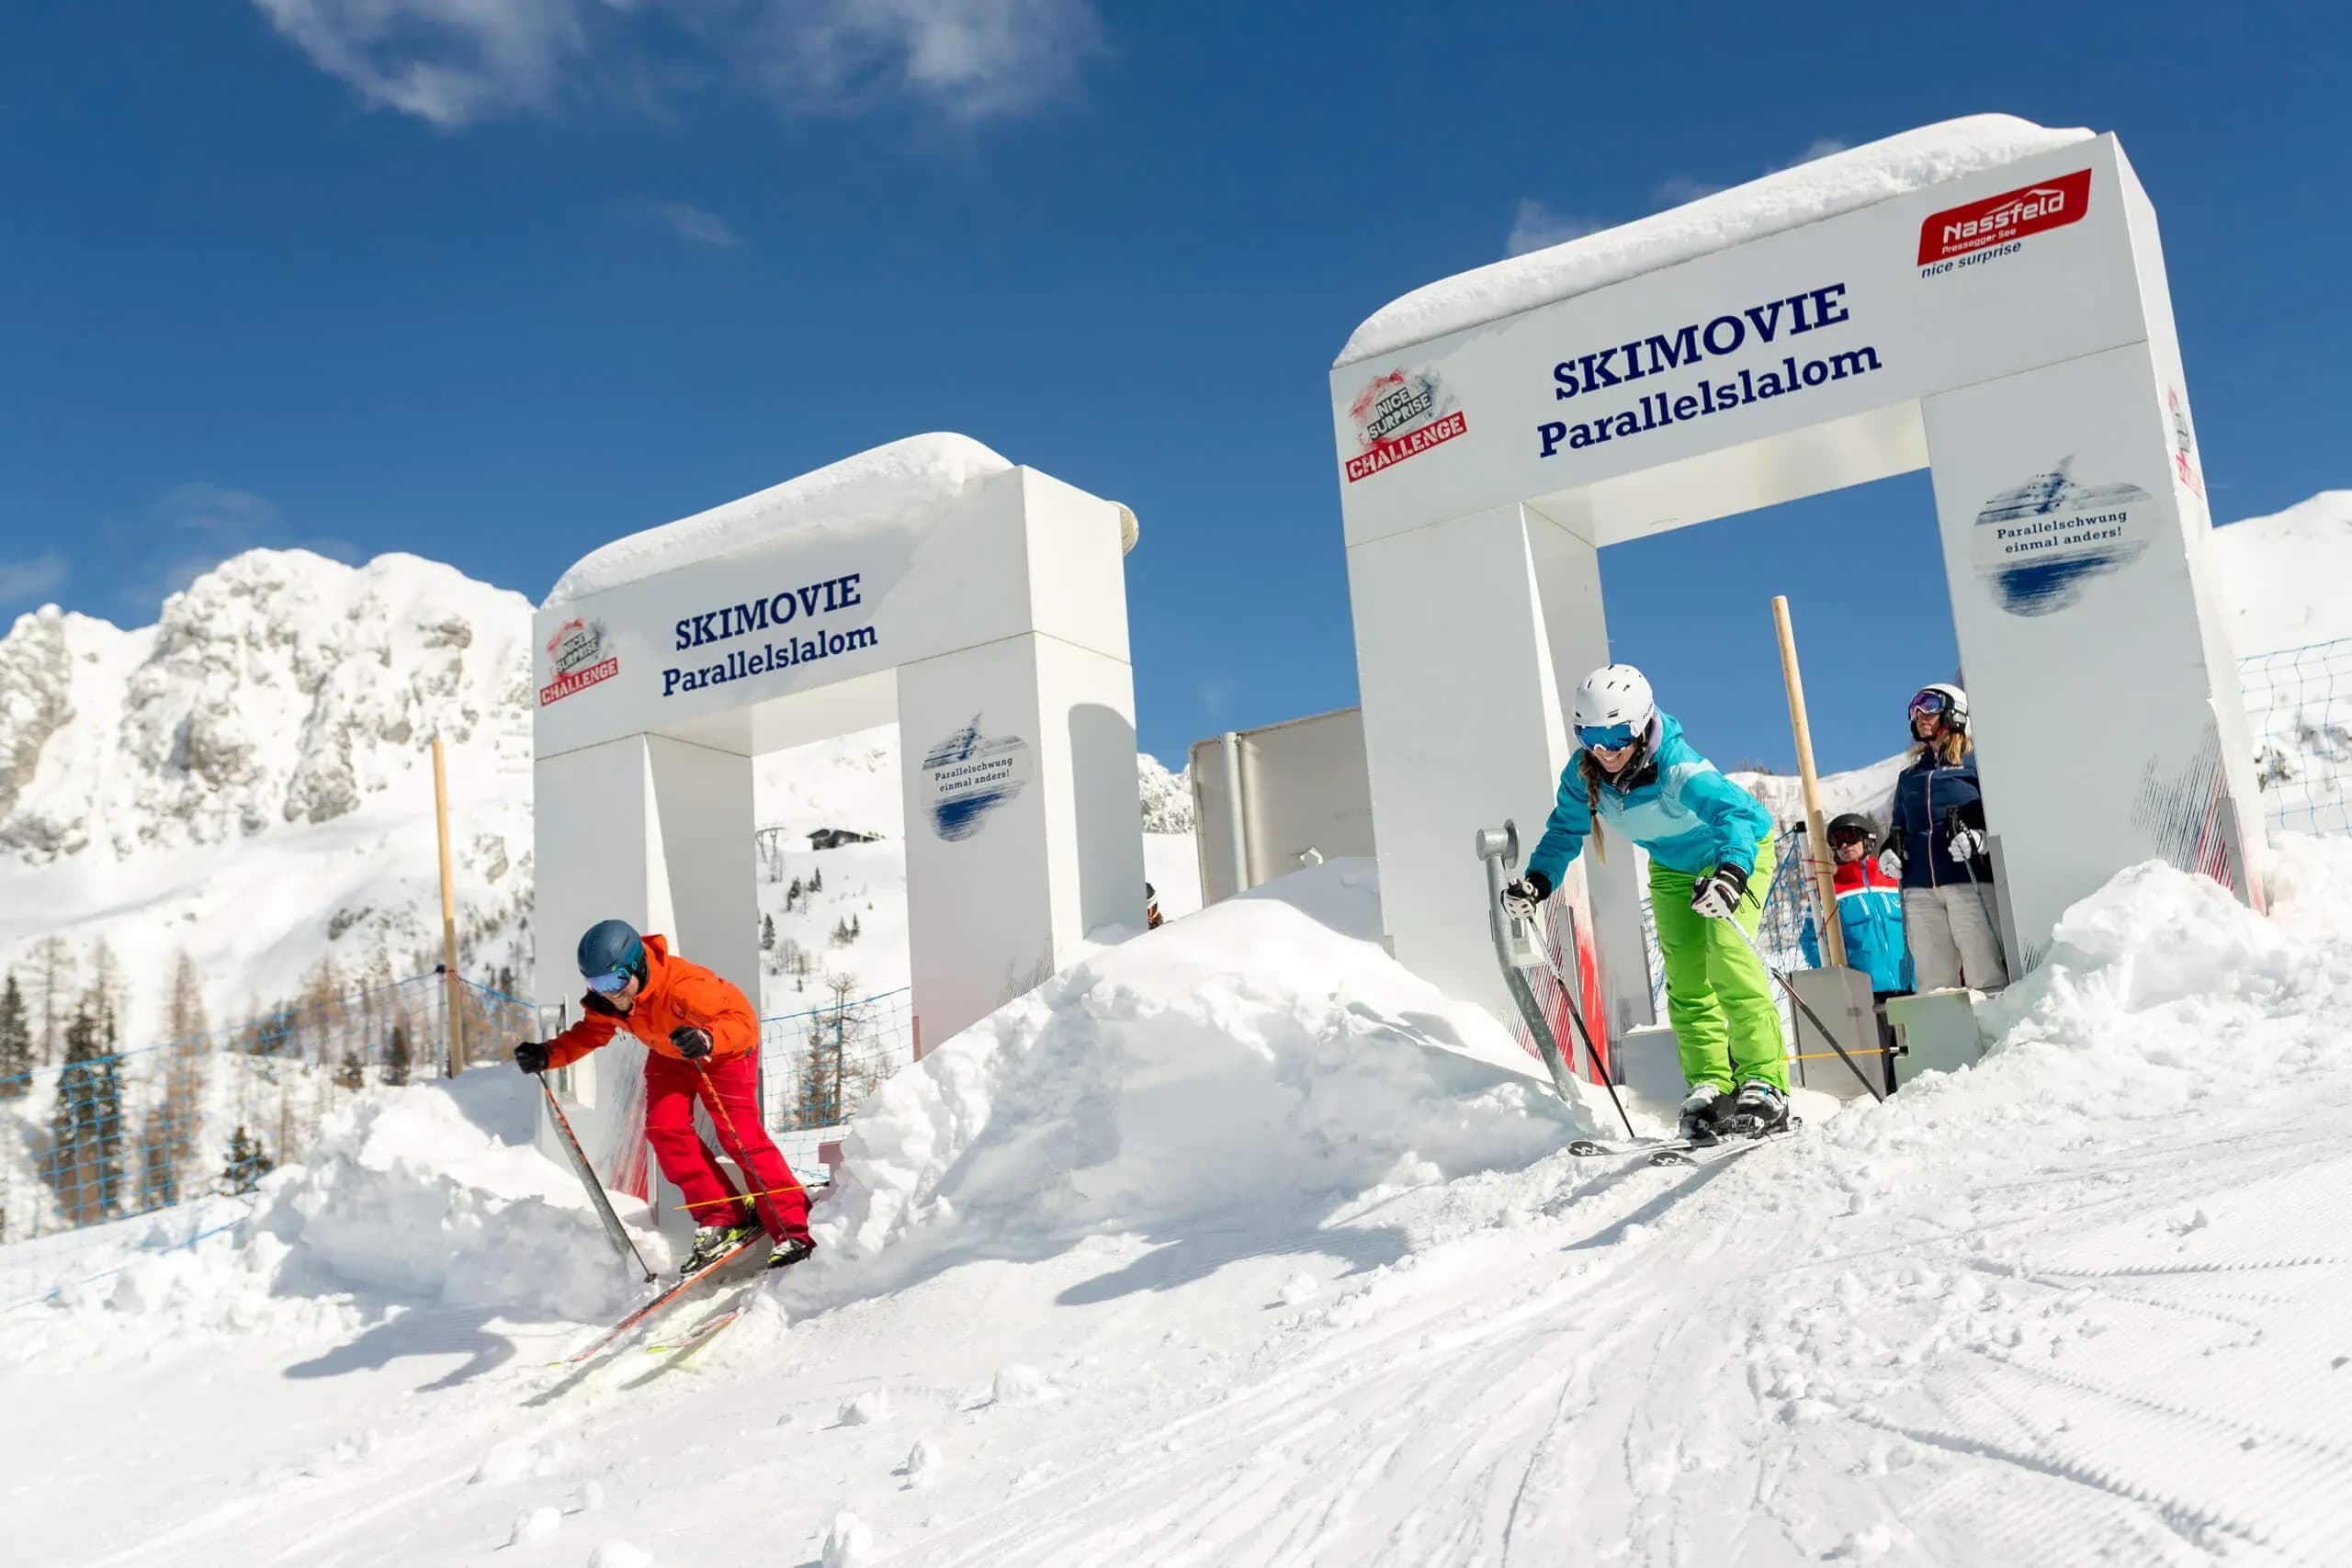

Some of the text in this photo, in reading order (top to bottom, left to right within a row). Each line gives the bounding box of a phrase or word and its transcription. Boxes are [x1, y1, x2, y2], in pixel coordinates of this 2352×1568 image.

[1942, 190, 2065, 243] Nassfeld
[1941, 227, 2018, 254] Pressegger See
[1921, 242, 2022, 279] nice surprise
[1553, 282, 1849, 400] SKIMOVIE
[1368, 393, 1431, 439] SURPRISE
[1377, 389, 1411, 418] NICE
[1537, 345, 1882, 457] Parallelslalom
[1349, 415, 1464, 479] CHALLENGE
[1996, 512, 2128, 540] Parallelschwung
[2005, 525, 2122, 554] einmal anders!
[675, 573, 861, 651] SKIMOVIE
[556, 638, 597, 672] SURPRISE
[563, 633, 586, 653] NICE
[662, 625, 878, 696] Parallelslalom
[541, 660, 616, 705] CHALLENGE
[934, 757, 1013, 781] Parallelschwung
[939, 769, 1010, 792] einmal anders!
